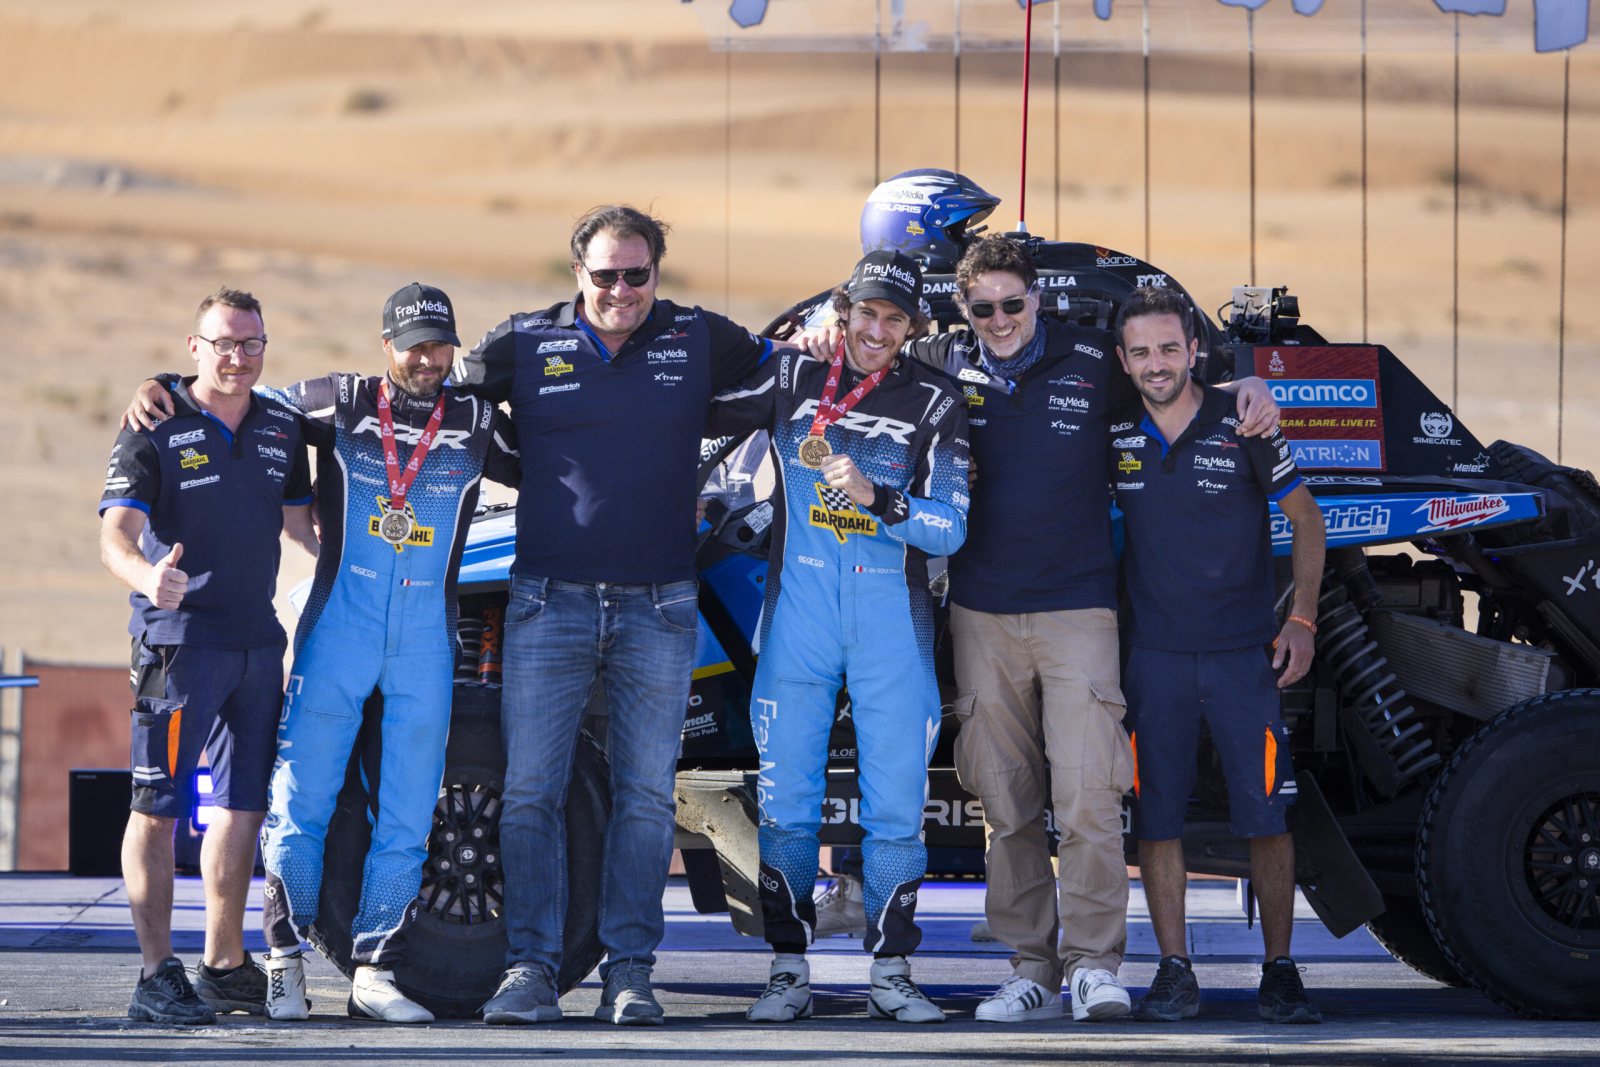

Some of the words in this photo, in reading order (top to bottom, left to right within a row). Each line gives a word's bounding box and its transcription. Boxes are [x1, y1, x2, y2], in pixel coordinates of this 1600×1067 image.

[1096, 256, 1137, 267] sparco
[864, 263, 916, 287] FrayMédia
[1136, 274, 1168, 288] FOX
[878, 276, 894, 285] MEDIA
[894, 281, 913, 294] FACTORY
[395, 299, 449, 319] FrayMédia
[399, 317, 412, 327] SPORT
[413, 314, 429, 322] MEDIA
[429, 314, 449, 322] FACTORY
[523, 318, 552, 329] sparco
[647, 349, 688, 361] FrayMédia
[1074, 343, 1104, 360] sparco
[545, 366, 572, 374] BARDAHL
[654, 372, 683, 382] X'treme
[780, 354, 791, 389] sparco
[539, 383, 581, 395] BFGoodrich
[1271, 385, 1368, 402] aramco
[1049, 396, 1089, 408] FrayMédia
[266, 408, 295, 422] sparco
[929, 396, 954, 426] sparco
[1051, 419, 1081, 431] X'treme
[1308, 419, 1339, 427] DARE.
[1341, 418, 1364, 427] LIVE
[1365, 418, 1377, 427] IT.
[169, 429, 206, 447] RZR
[1413, 436, 1462, 446] SIMECATEC
[1293, 444, 1370, 463] ATRION
[1194, 455, 1235, 468] FrayMédia
[180, 474, 221, 489] BFGoodrich
[1197, 478, 1228, 490] X'treme
[1429, 496, 1504, 521] Milwaukee
[812, 509, 874, 532] BARDAHL
[371, 520, 431, 543] BAHL
[798, 555, 824, 568] sparco
[350, 565, 377, 579] sparco
[684, 711, 714, 728] max
[702, 727, 719, 735] Pads
